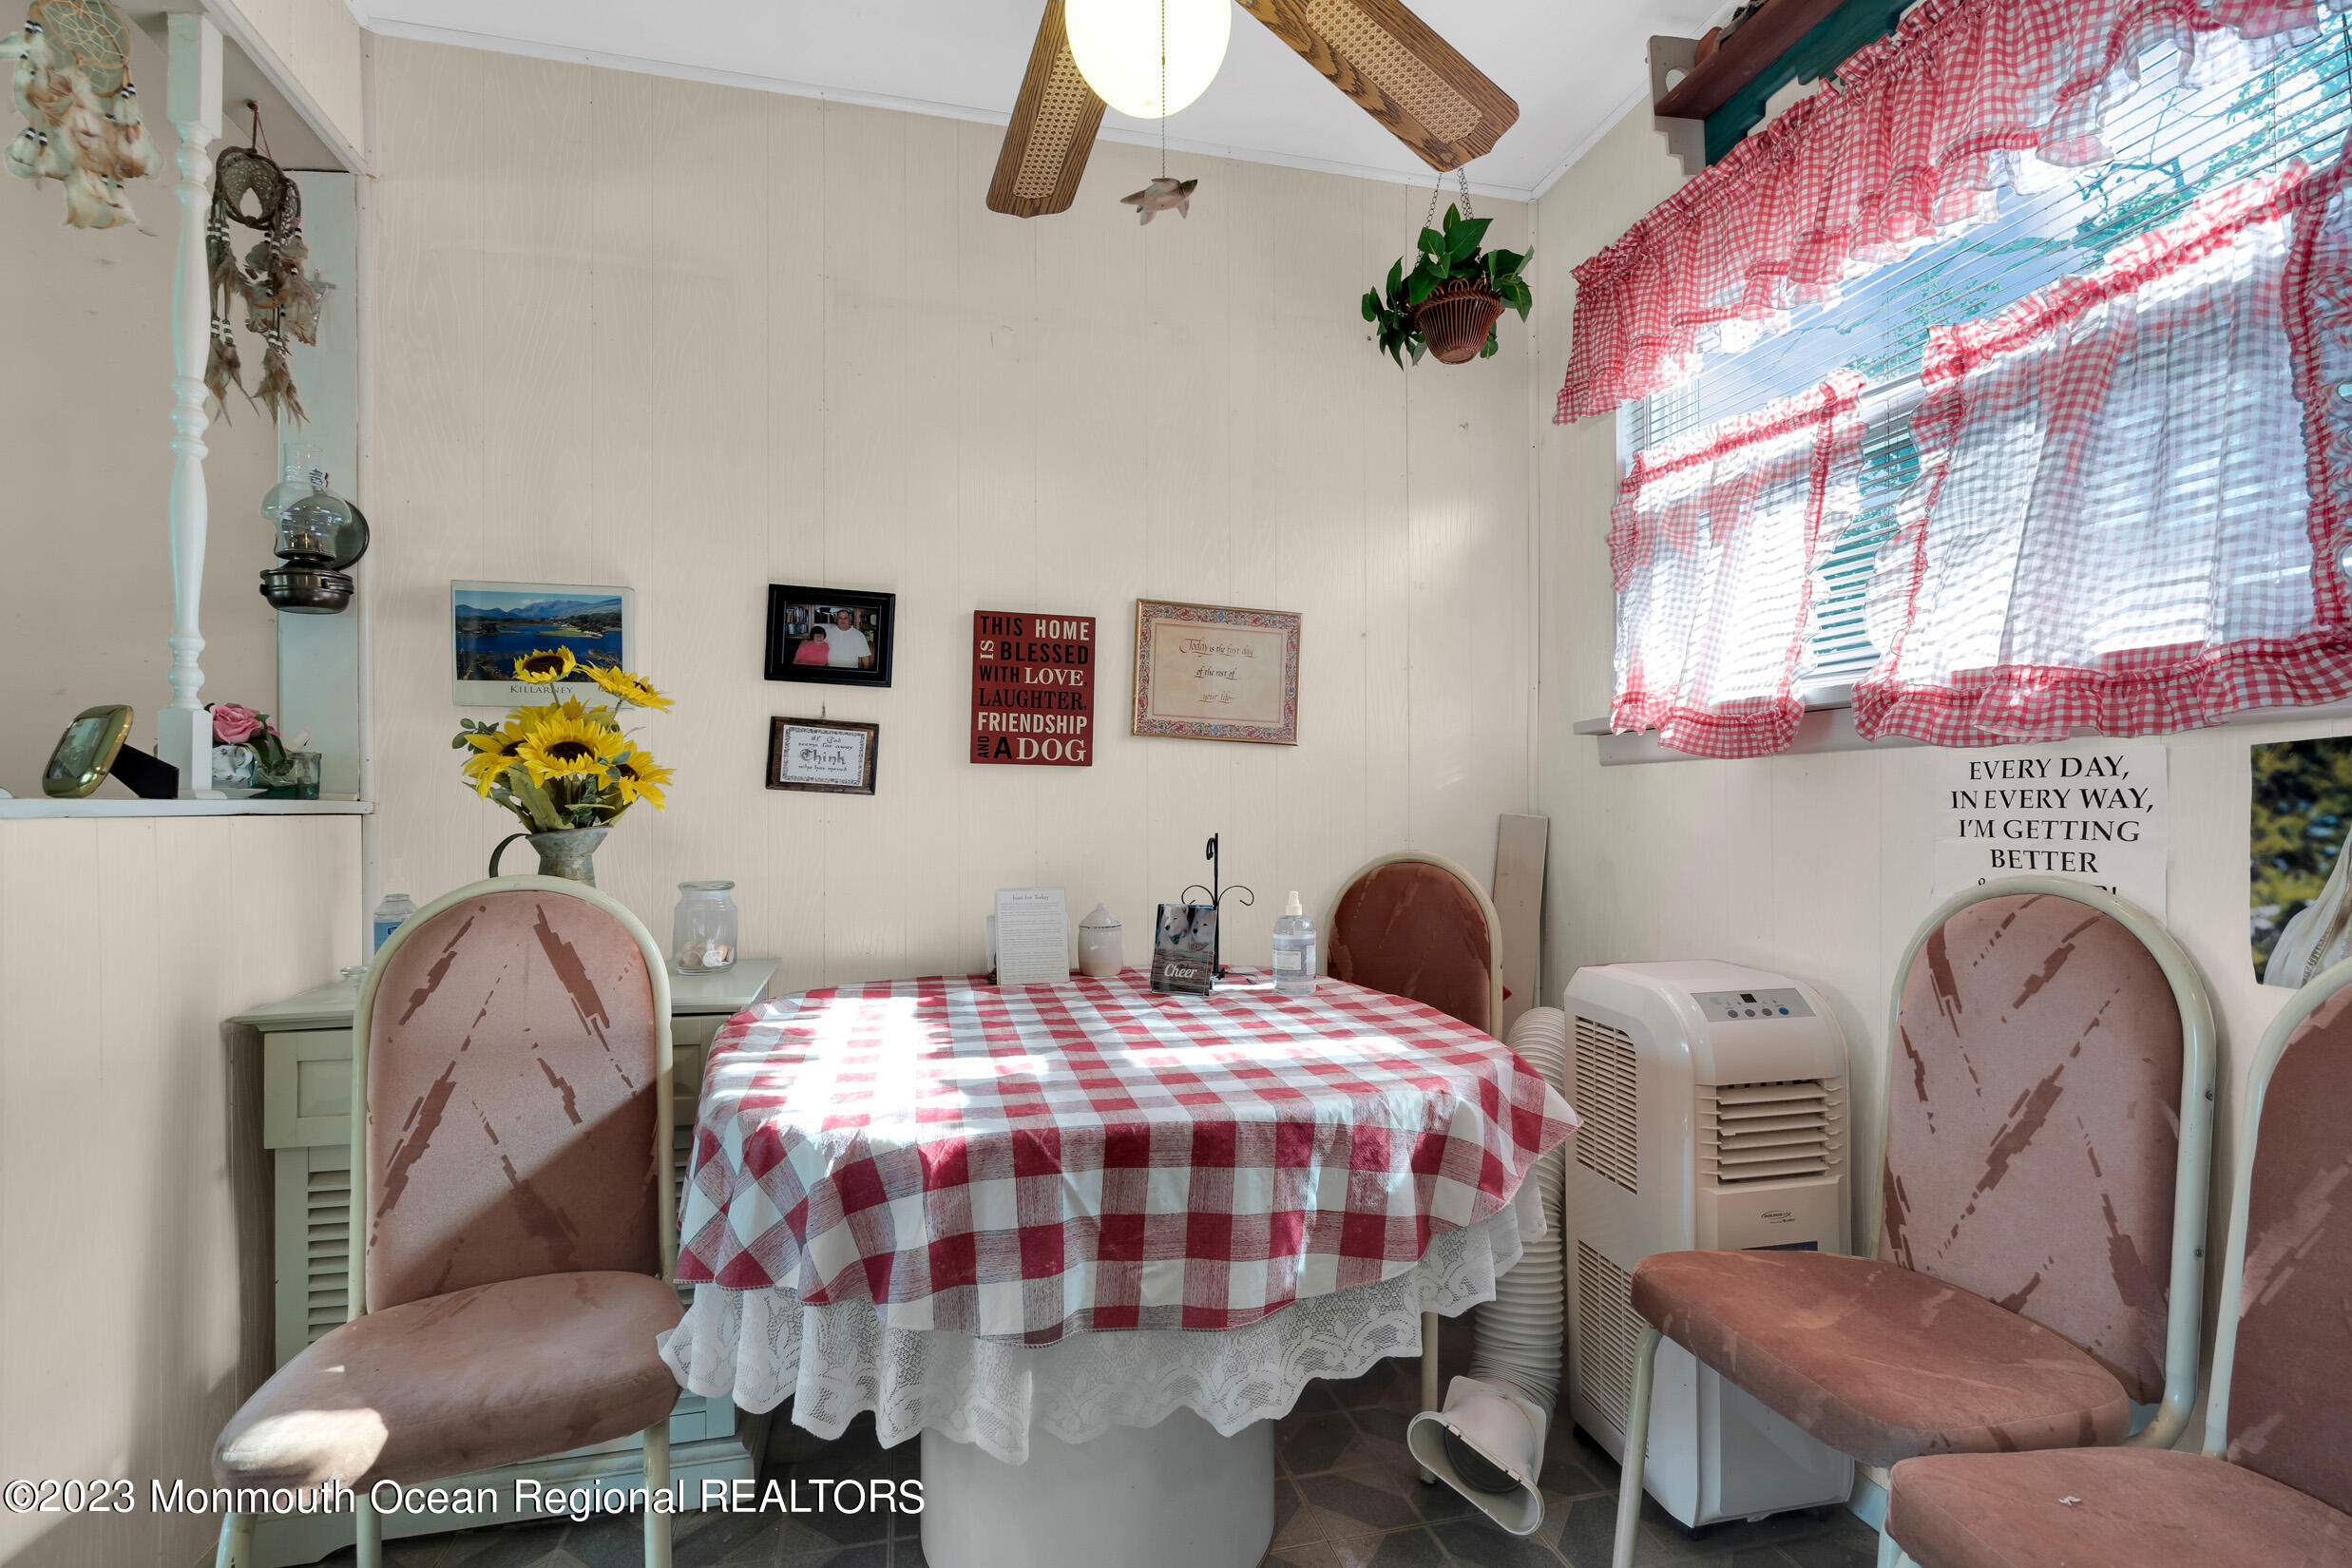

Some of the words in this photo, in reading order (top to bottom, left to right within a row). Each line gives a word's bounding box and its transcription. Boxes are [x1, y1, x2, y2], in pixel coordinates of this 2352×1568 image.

[981, 616, 1023, 637] THIS
[1035, 619, 1090, 641] HOME
[980, 640, 994, 660] IS
[1001, 641, 1089, 664] BLESSED
[979, 666, 1020, 683] WITH
[1024, 667, 1088, 686] LOVE,
[979, 687, 1087, 710] LAUGHTER,
[978, 712, 1088, 735] FRIENDSHIP
[800, 748, 847, 765] Think
[977, 736, 989, 758] AND
[993, 736, 1012, 758] A
[1016, 737, 1087, 762] DOG
[1969, 757, 2052, 780] EVERY
[2060, 755, 2130, 780] DAY,
[1951, 790, 1978, 810] IN
[1984, 789, 2071, 809] EVERY
[2078, 787, 2153, 813] WAY,
[1959, 819, 1995, 838] I'M
[2003, 819, 2140, 842] GETTING
[1990, 849, 2099, 873] BETTER
[1163, 964, 1197, 978] Cheer
